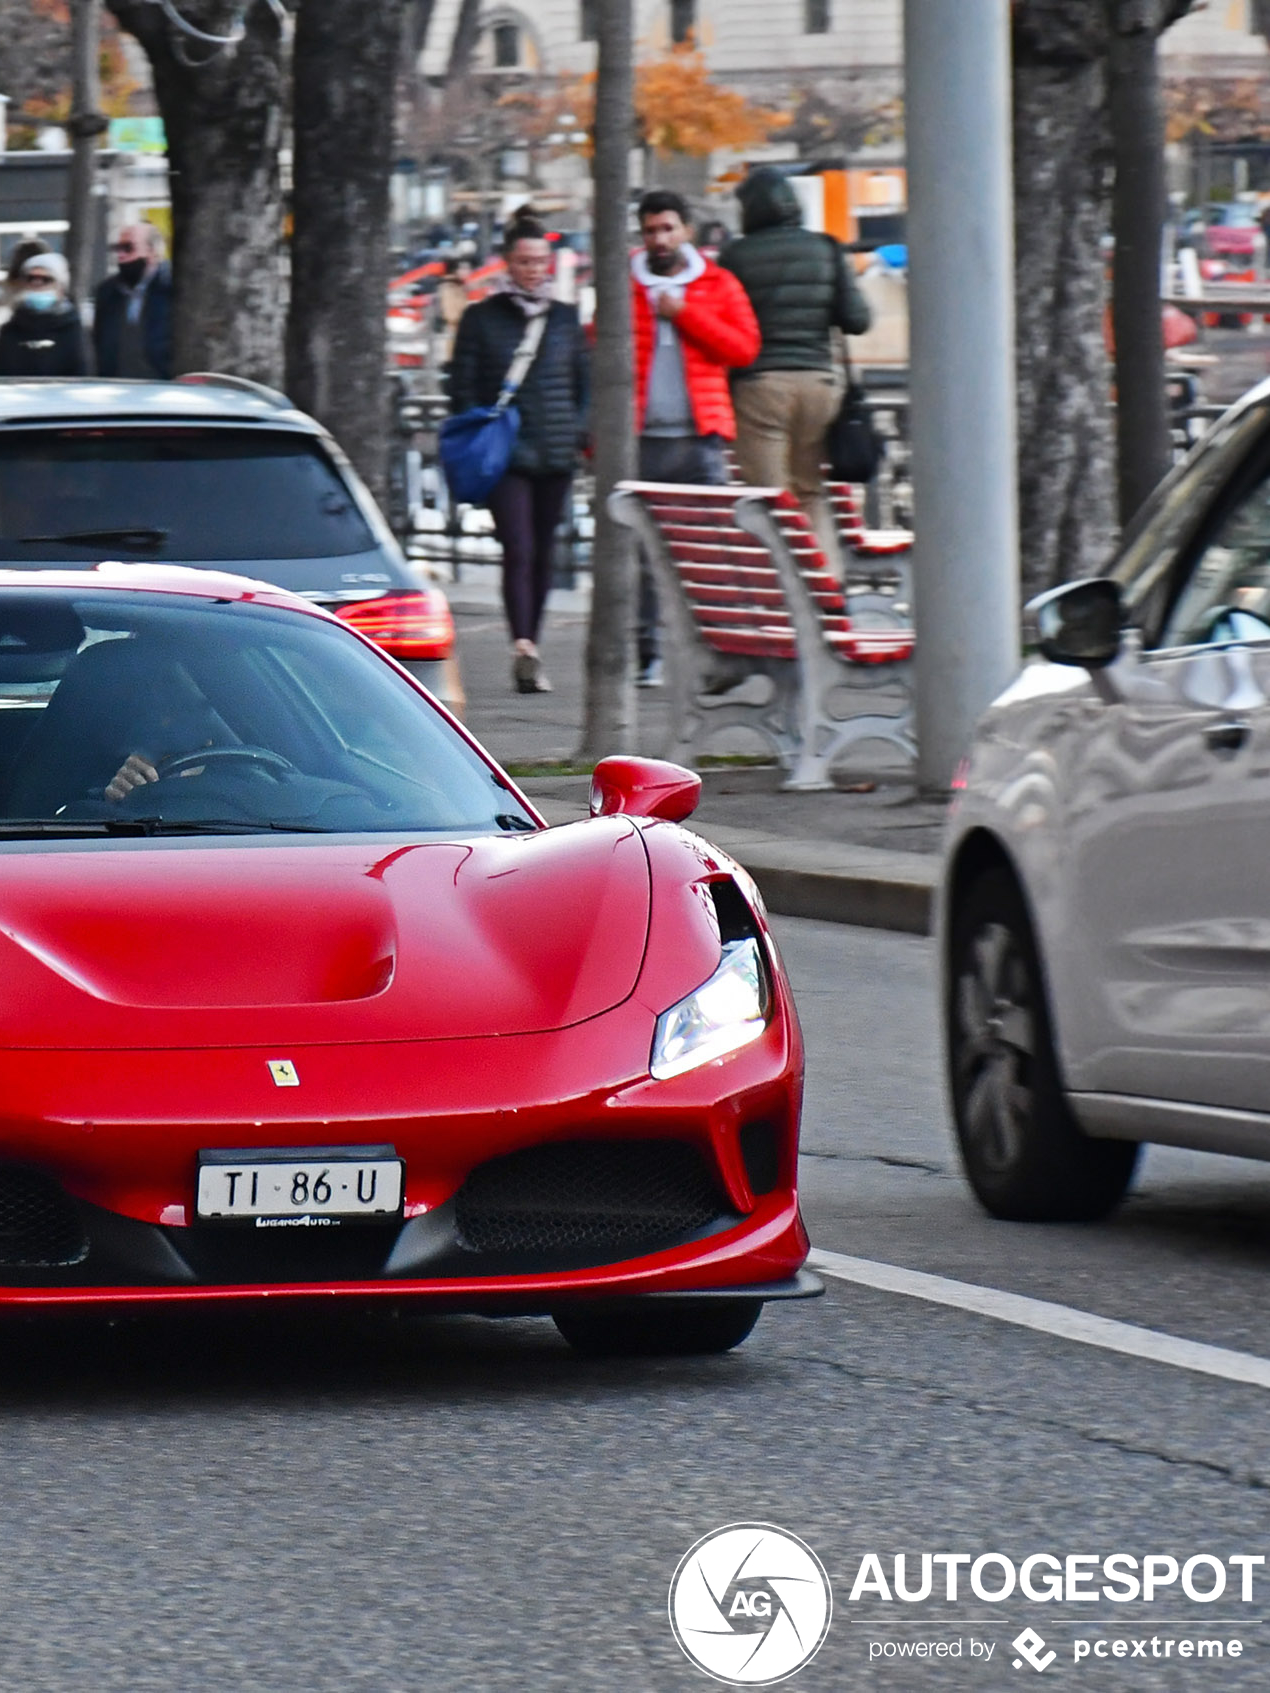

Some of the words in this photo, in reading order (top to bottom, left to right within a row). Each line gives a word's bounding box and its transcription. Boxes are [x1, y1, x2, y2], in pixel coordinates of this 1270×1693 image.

[225, 1171, 259, 1207] TI
[291, 1169, 332, 1206] 86
[357, 1168, 378, 1204] U
